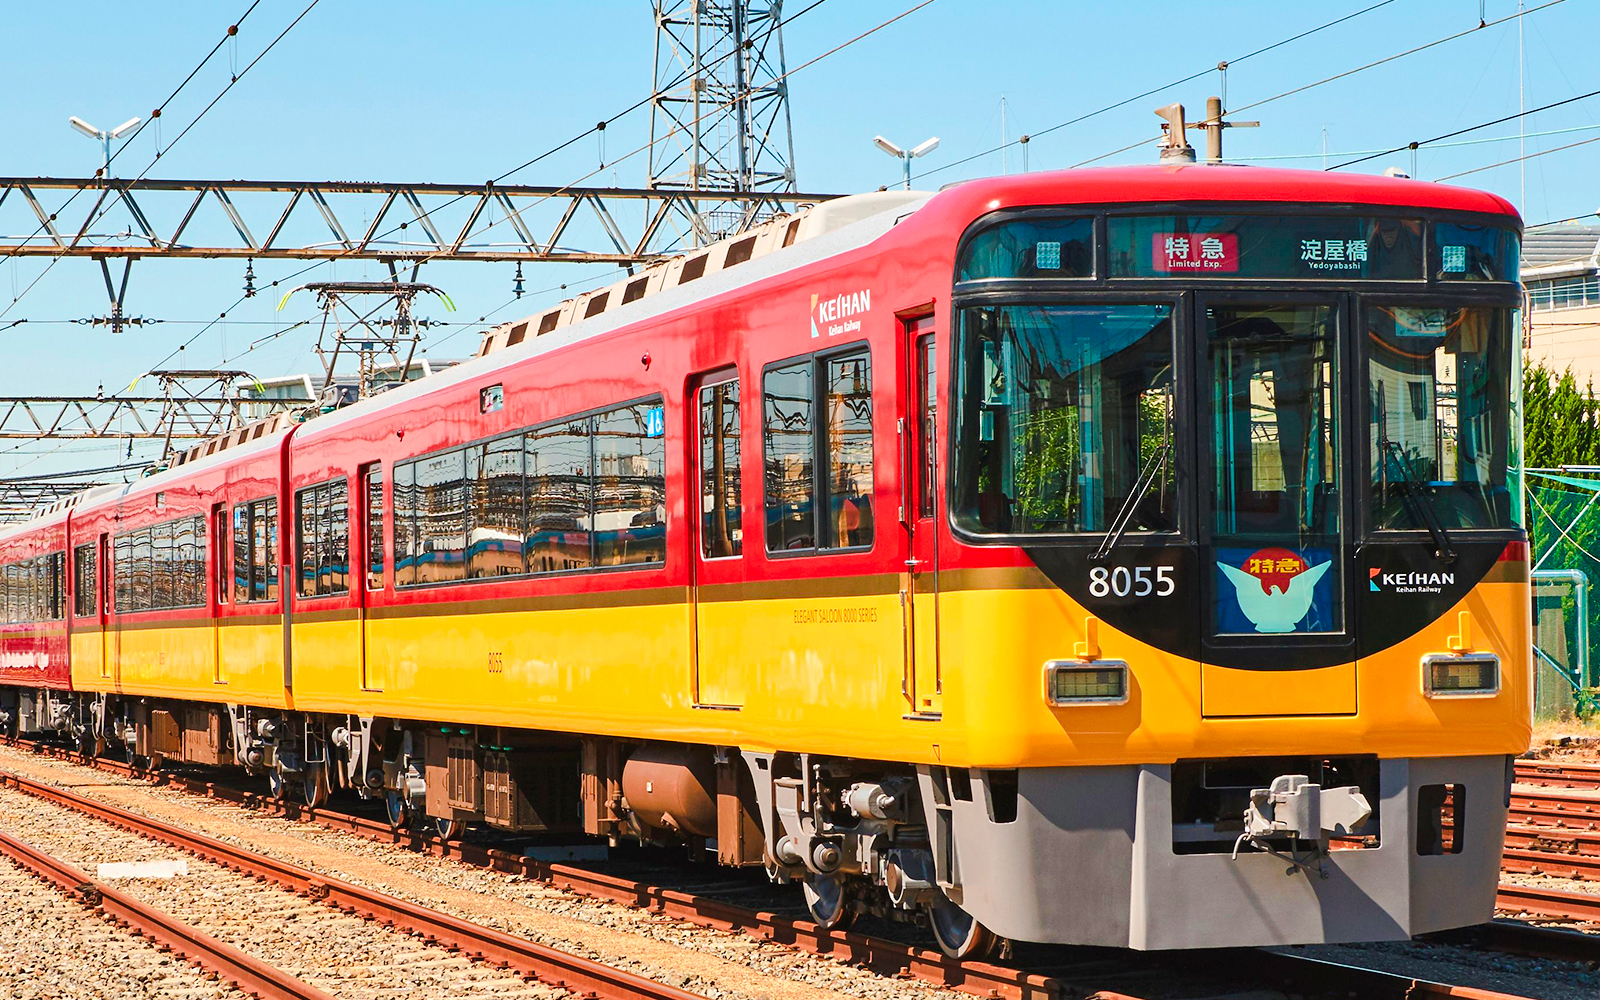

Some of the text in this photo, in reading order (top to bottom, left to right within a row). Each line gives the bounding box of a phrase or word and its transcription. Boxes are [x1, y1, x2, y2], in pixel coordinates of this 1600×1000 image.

[1165, 237, 1225, 260] 特急
[1300, 239, 1368, 261] 淀屋橋
[1168, 260, 1222, 269] Limited Exp.
[1308, 262, 1361, 271] Yedoyabashi
[819, 289, 871, 324] KEIHAN
[828, 320, 861, 337] Keihan Railway
[1250, 558, 1300, 574] 特急
[1089, 566, 1175, 597] 8055
[1382, 571, 1455, 585] KEIHAN
[1418, 586, 1442, 594] Railway
[793, 607, 878, 624] ELEGANT SALOON 8000 SERIES
[488, 652, 503, 673] 8055
